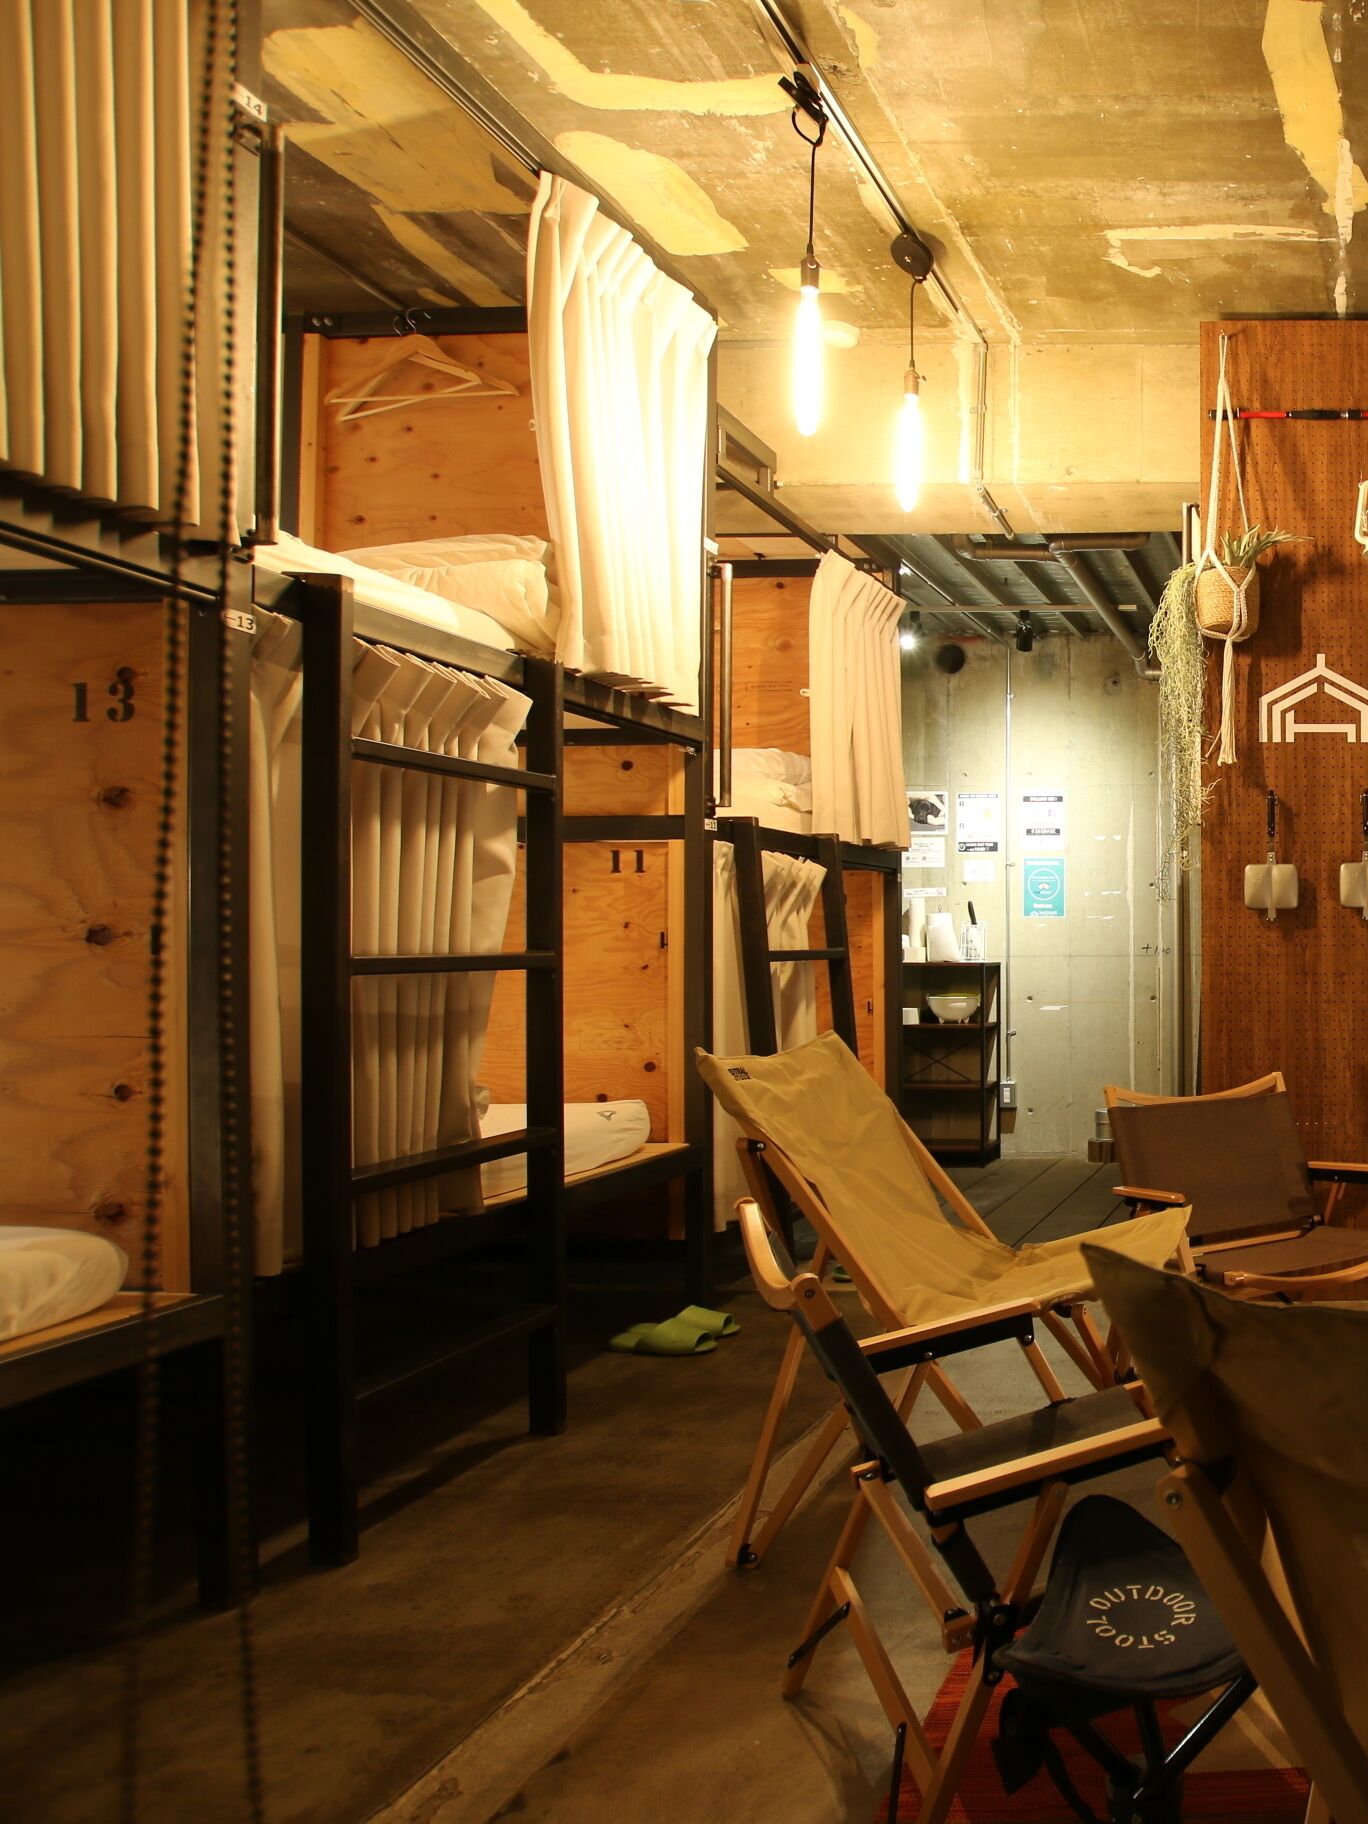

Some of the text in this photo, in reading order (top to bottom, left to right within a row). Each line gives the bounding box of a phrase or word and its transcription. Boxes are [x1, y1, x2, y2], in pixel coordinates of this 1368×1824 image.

[237, 615, 254, 631] 13
[72, 681, 136, 722] 13
[610, 849, 646, 873] 11
[1089, 1585, 1197, 1626] OUTDOOR
[1086, 1615, 1176, 1649] STOOL
